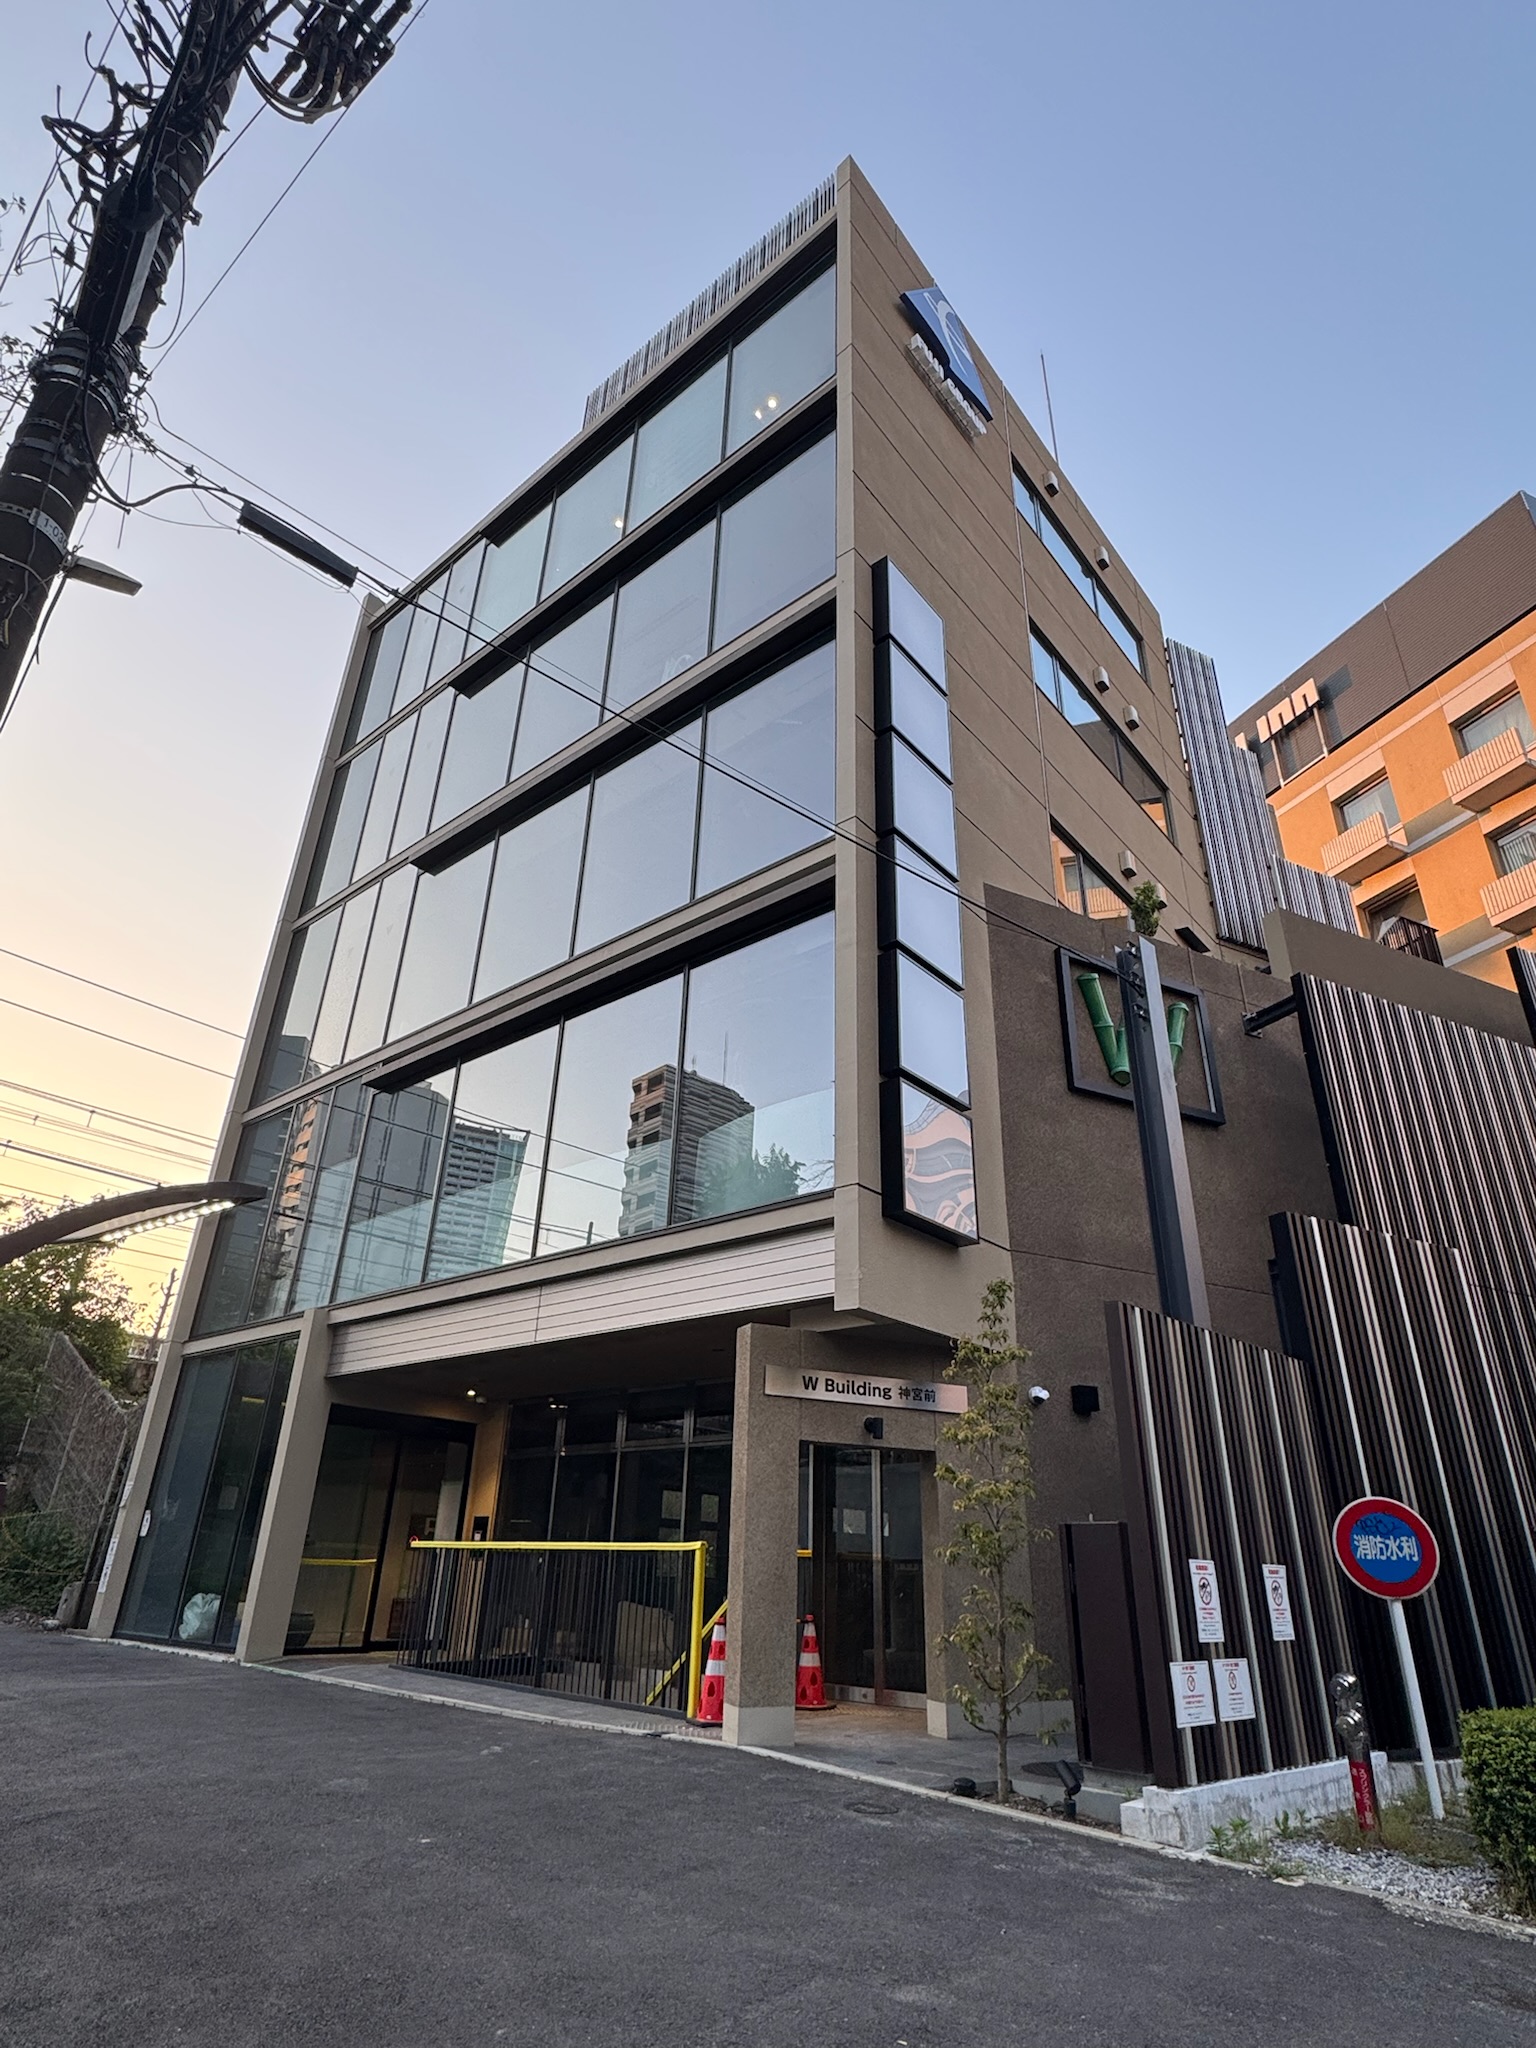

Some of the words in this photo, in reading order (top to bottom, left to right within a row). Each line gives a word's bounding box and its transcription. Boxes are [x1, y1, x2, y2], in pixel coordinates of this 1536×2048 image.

[802, 1375, 819, 1391] W
[824, 1377, 893, 1400] Building
[898, 1386, 936, 1403] 神宮前
[1353, 1534, 1419, 1561] 消防水利
